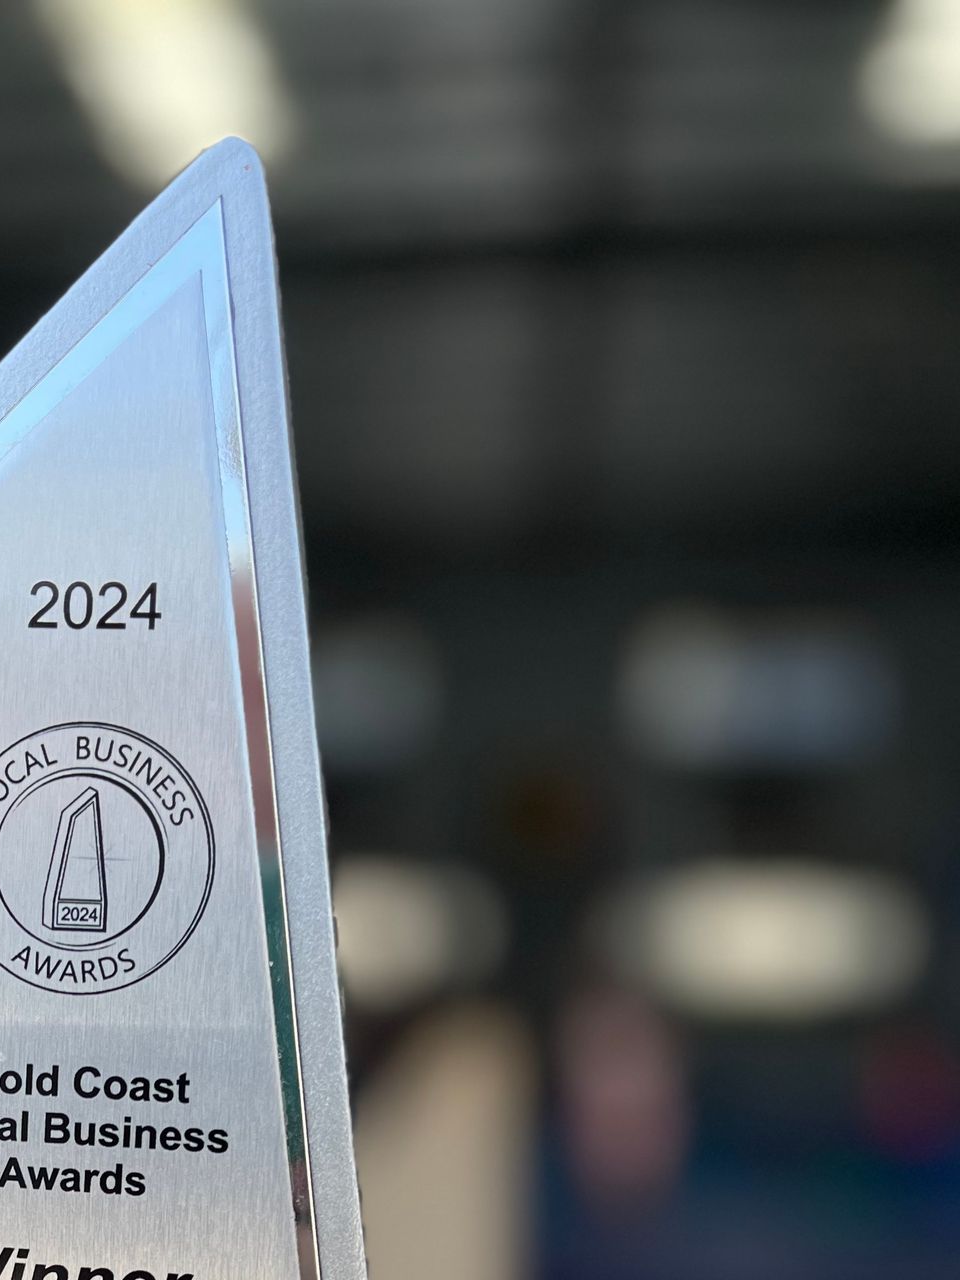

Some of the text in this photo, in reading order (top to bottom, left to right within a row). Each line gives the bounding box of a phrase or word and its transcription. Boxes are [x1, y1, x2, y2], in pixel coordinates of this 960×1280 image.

[28, 580, 161, 630] 2024
[76, 736, 194, 826] BUSINESS
[61, 906, 98, 922] 2024
[11, 945, 136, 983] AWARDS
[73, 1066, 190, 1104] Coast
[44, 1112, 229, 1153] Business
